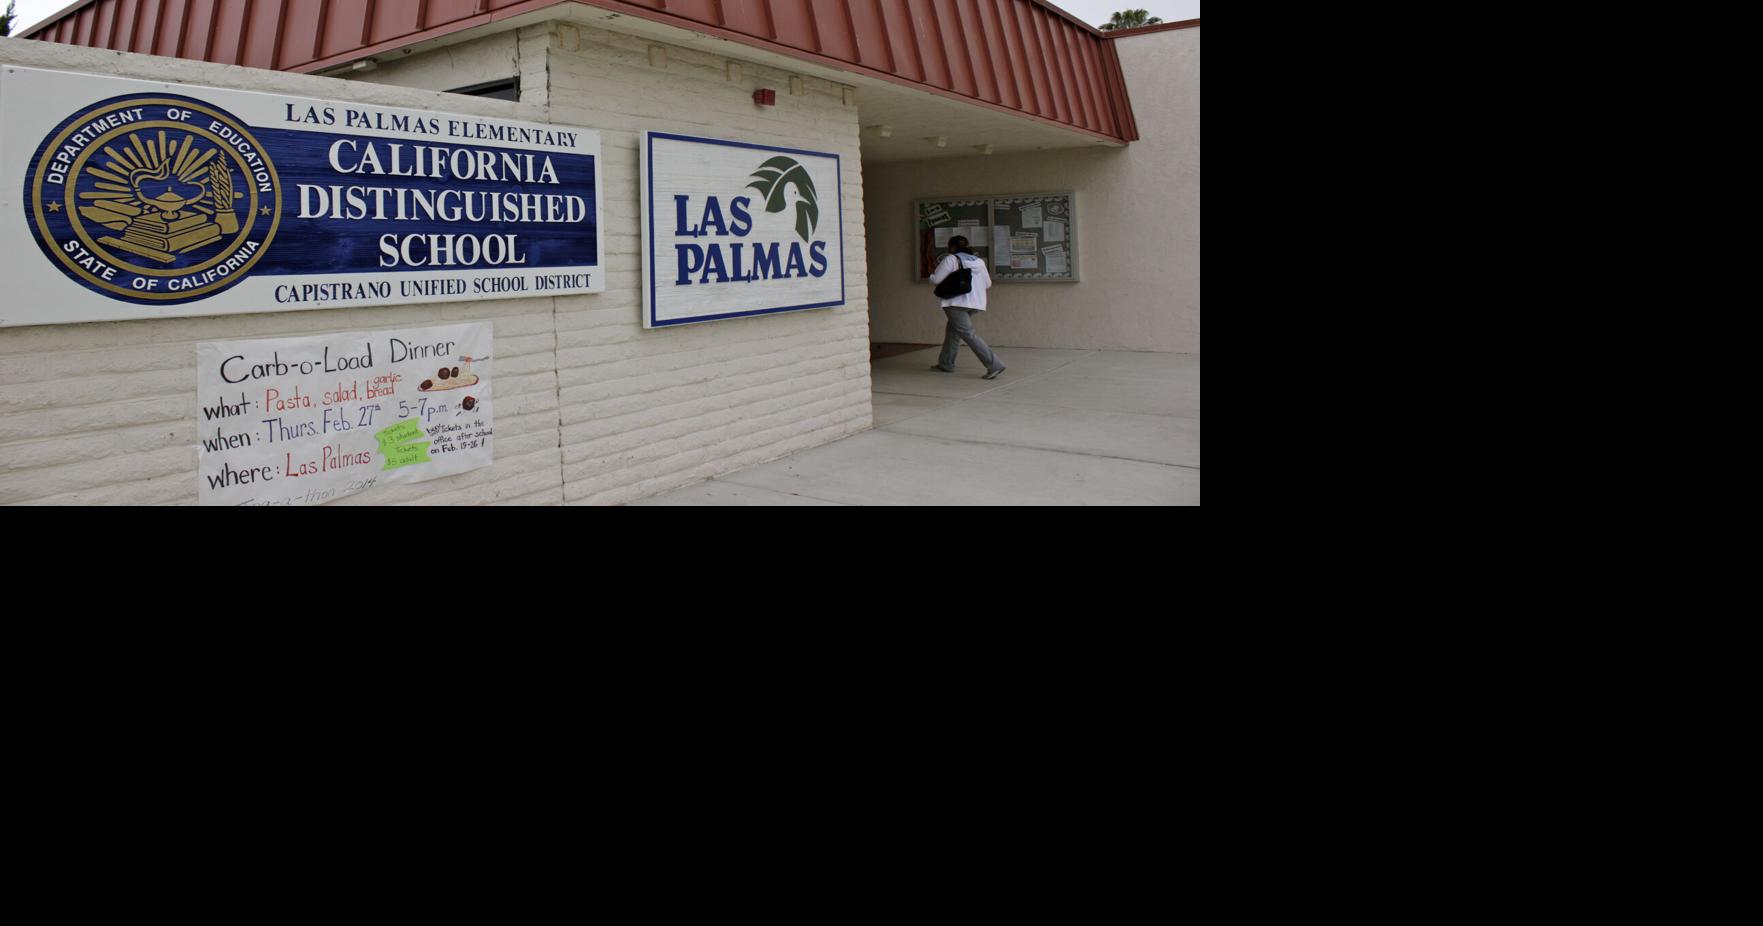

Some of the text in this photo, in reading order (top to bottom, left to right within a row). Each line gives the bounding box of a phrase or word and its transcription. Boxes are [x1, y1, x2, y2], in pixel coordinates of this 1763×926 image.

[286, 103, 578, 148] LAS PALMAS ELEMENTARY
[47, 108, 272, 192] DEPARTMENT OF EDUCATION
[328, 139, 560, 184] CALIFORNIA
[297, 184, 586, 223] DISTINGUISHED
[674, 194, 753, 238] LAS
[63, 239, 260, 291] STATE OF CALIFORNIA
[379, 233, 526, 267] SCHOOL
[674, 240, 828, 286] PALMAS
[274, 273, 591, 303] CAPISTRANO UNIFIED SCHOOL DISTRICT
[220, 338, 455, 384] Carb-o-Load Dinner
[366, 380, 395, 400] bread
[285, 452, 318, 478] Las
[322, 443, 371, 473] Palmas
